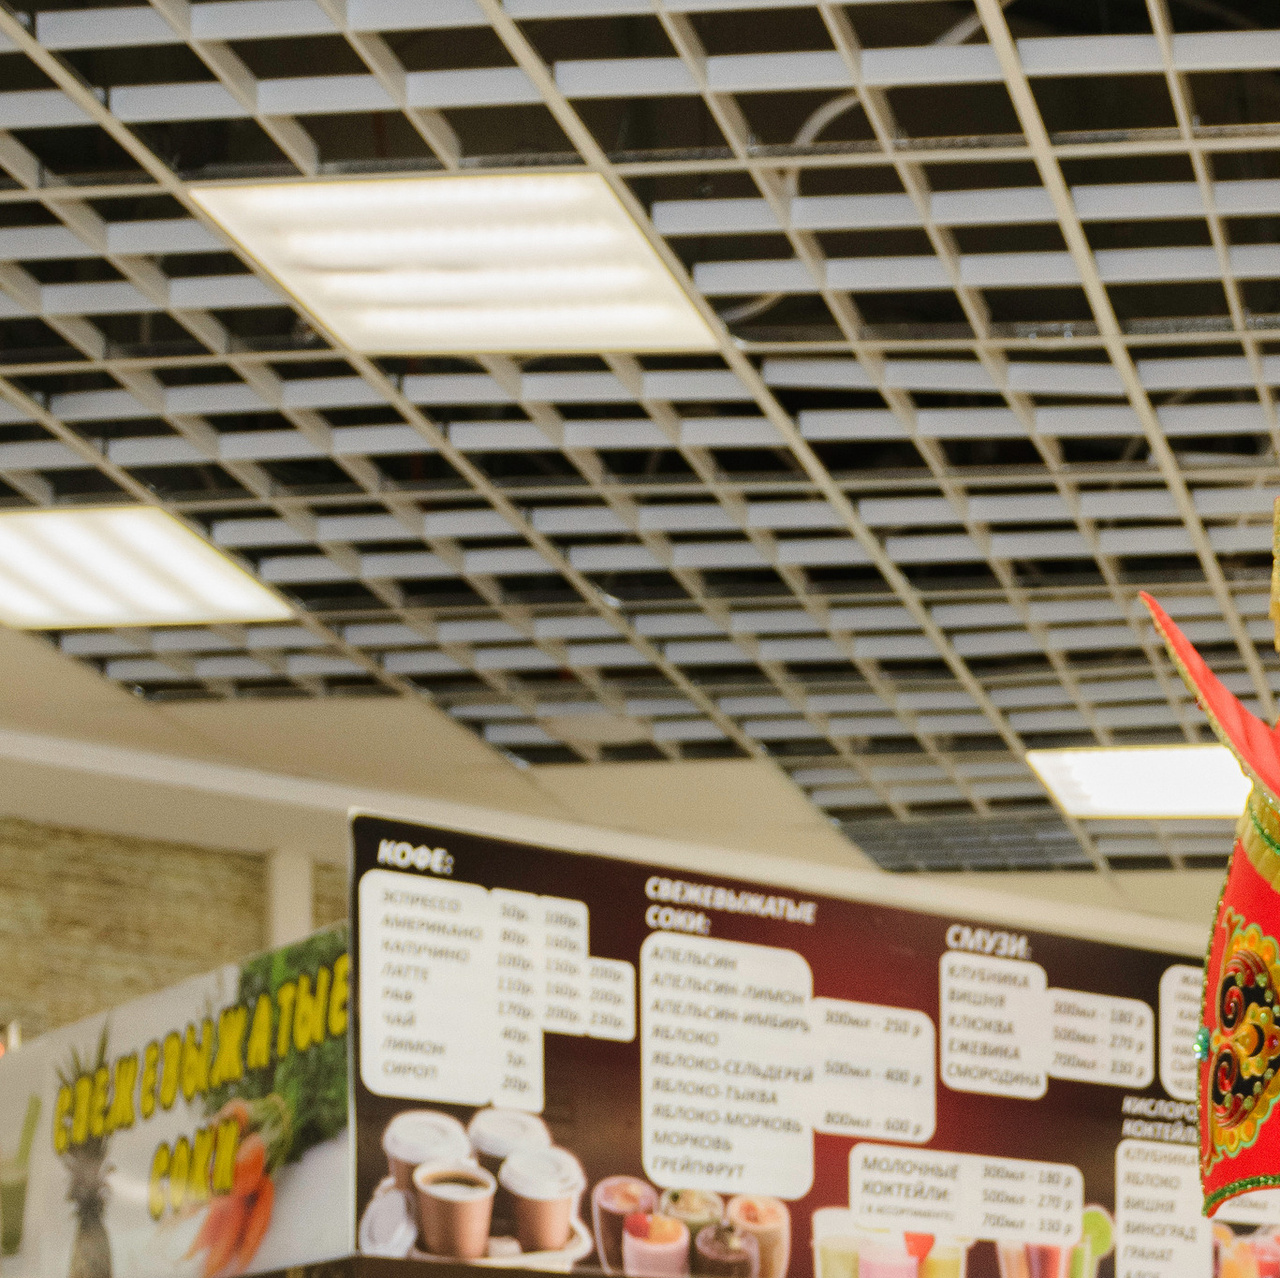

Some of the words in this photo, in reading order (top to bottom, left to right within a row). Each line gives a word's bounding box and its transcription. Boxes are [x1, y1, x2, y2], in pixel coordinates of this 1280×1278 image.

[377, 840, 454, 876] КОФЕ:
[645, 875, 816, 926] СВЕЖЕВЫЖАТЫЕ
[650, 945, 738, 970] АПЕЛЬСИН
[948, 965, 1031, 989] КЛУБНИКА
[948, 988, 1007, 1009] ВИШНЯ
[383, 1012, 415, 1029] ЧАЙ
[948, 1013, 1015, 1035] КЛЮКВА
[383, 1037, 445, 1057] ЛИМОН
[650, 1023, 720, 1048] ЯБЛОКО
[948, 1037, 1022, 1060] ЕЖЕВИКА
[383, 1062, 438, 1080] СИРОП
[946, 1062, 1042, 1088] СМОРОДИНА
[1122, 1096, 1199, 1121] КИСЛОРО
[651, 1129, 734, 1153] МОРКОВЬ
[1122, 1117, 1199, 1143] КОКТЕЙЛ
[651, 1154, 746, 1179] ГРЕЙПФРУТ
[861, 1154, 960, 1181] МОЛОЧНЫЕ
[1124, 1147, 1198, 1167] КЛУБНИКА
[1124, 1171, 1182, 1191] ЯБЛОКО
[1124, 1196, 1177, 1215] ВИШНЯ
[1124, 1221, 1199, 1244] ВИНОГРАД
